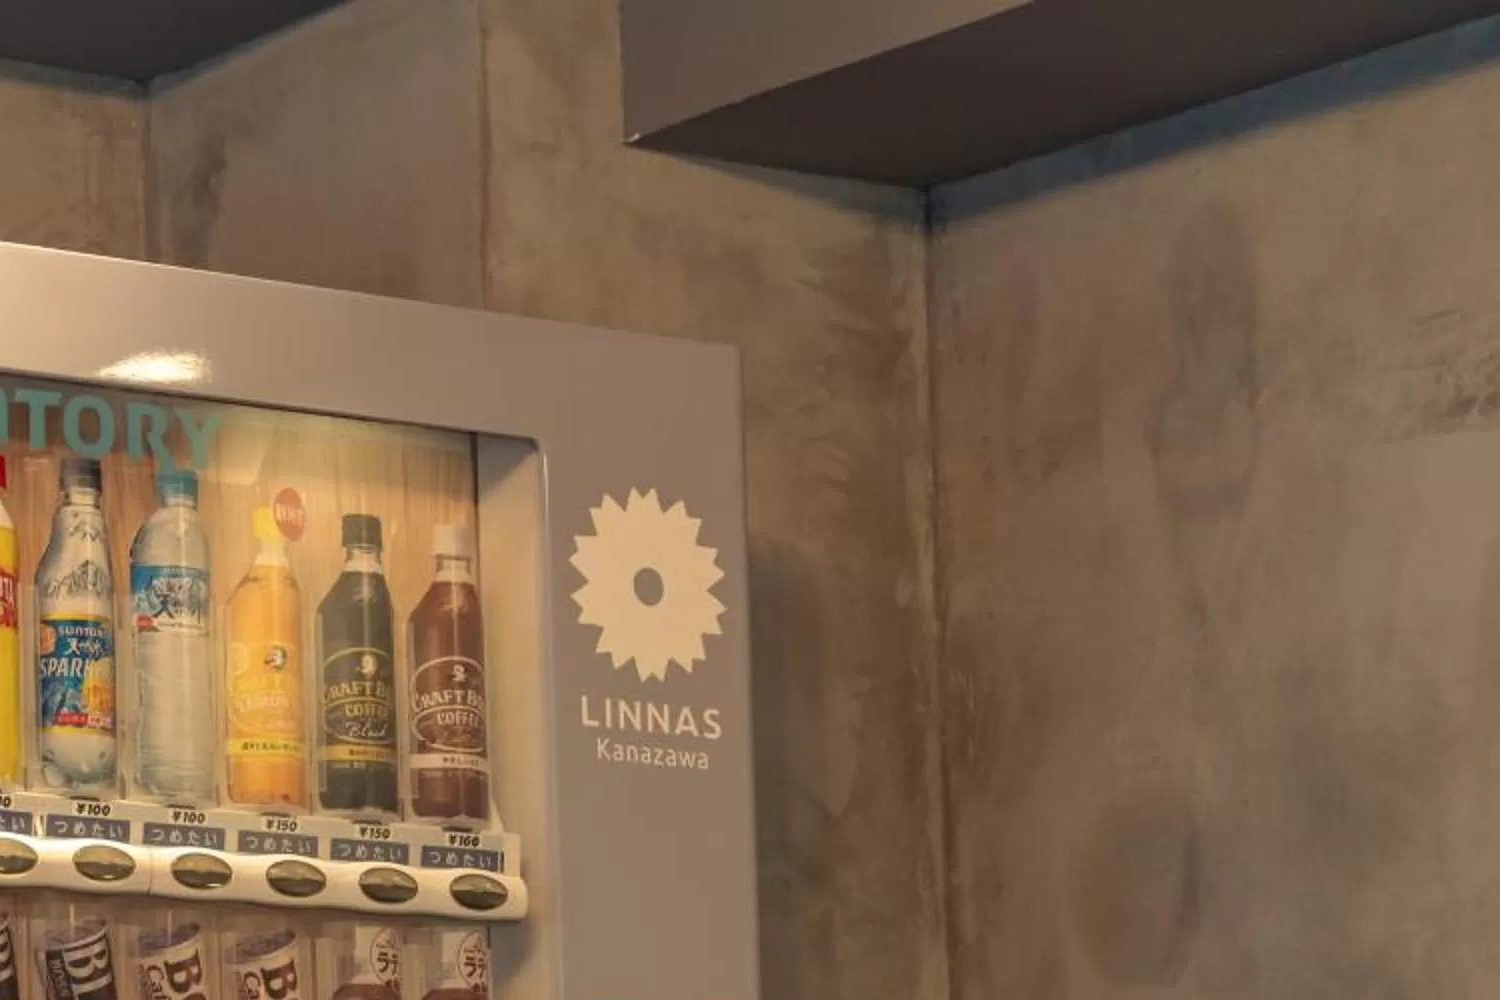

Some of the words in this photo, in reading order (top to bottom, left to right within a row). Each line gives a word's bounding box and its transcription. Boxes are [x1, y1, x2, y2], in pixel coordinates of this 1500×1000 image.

[414, 689, 465, 713] CRAFT
[581, 695, 722, 740] LINNAS
[596, 737, 709, 770] Kanazawa
[76, 803, 112, 816] ¥100
[172, 811, 206, 824] ¥100
[54, 821, 123, 839] つめたい
[266, 819, 298, 832] ¥150
[359, 826, 391, 839] ¥150
[152, 828, 218, 848] つめたい
[245, 835, 313, 855] つめたい
[338, 843, 402, 861] つめたい
[429, 851, 493, 868] つめたい
